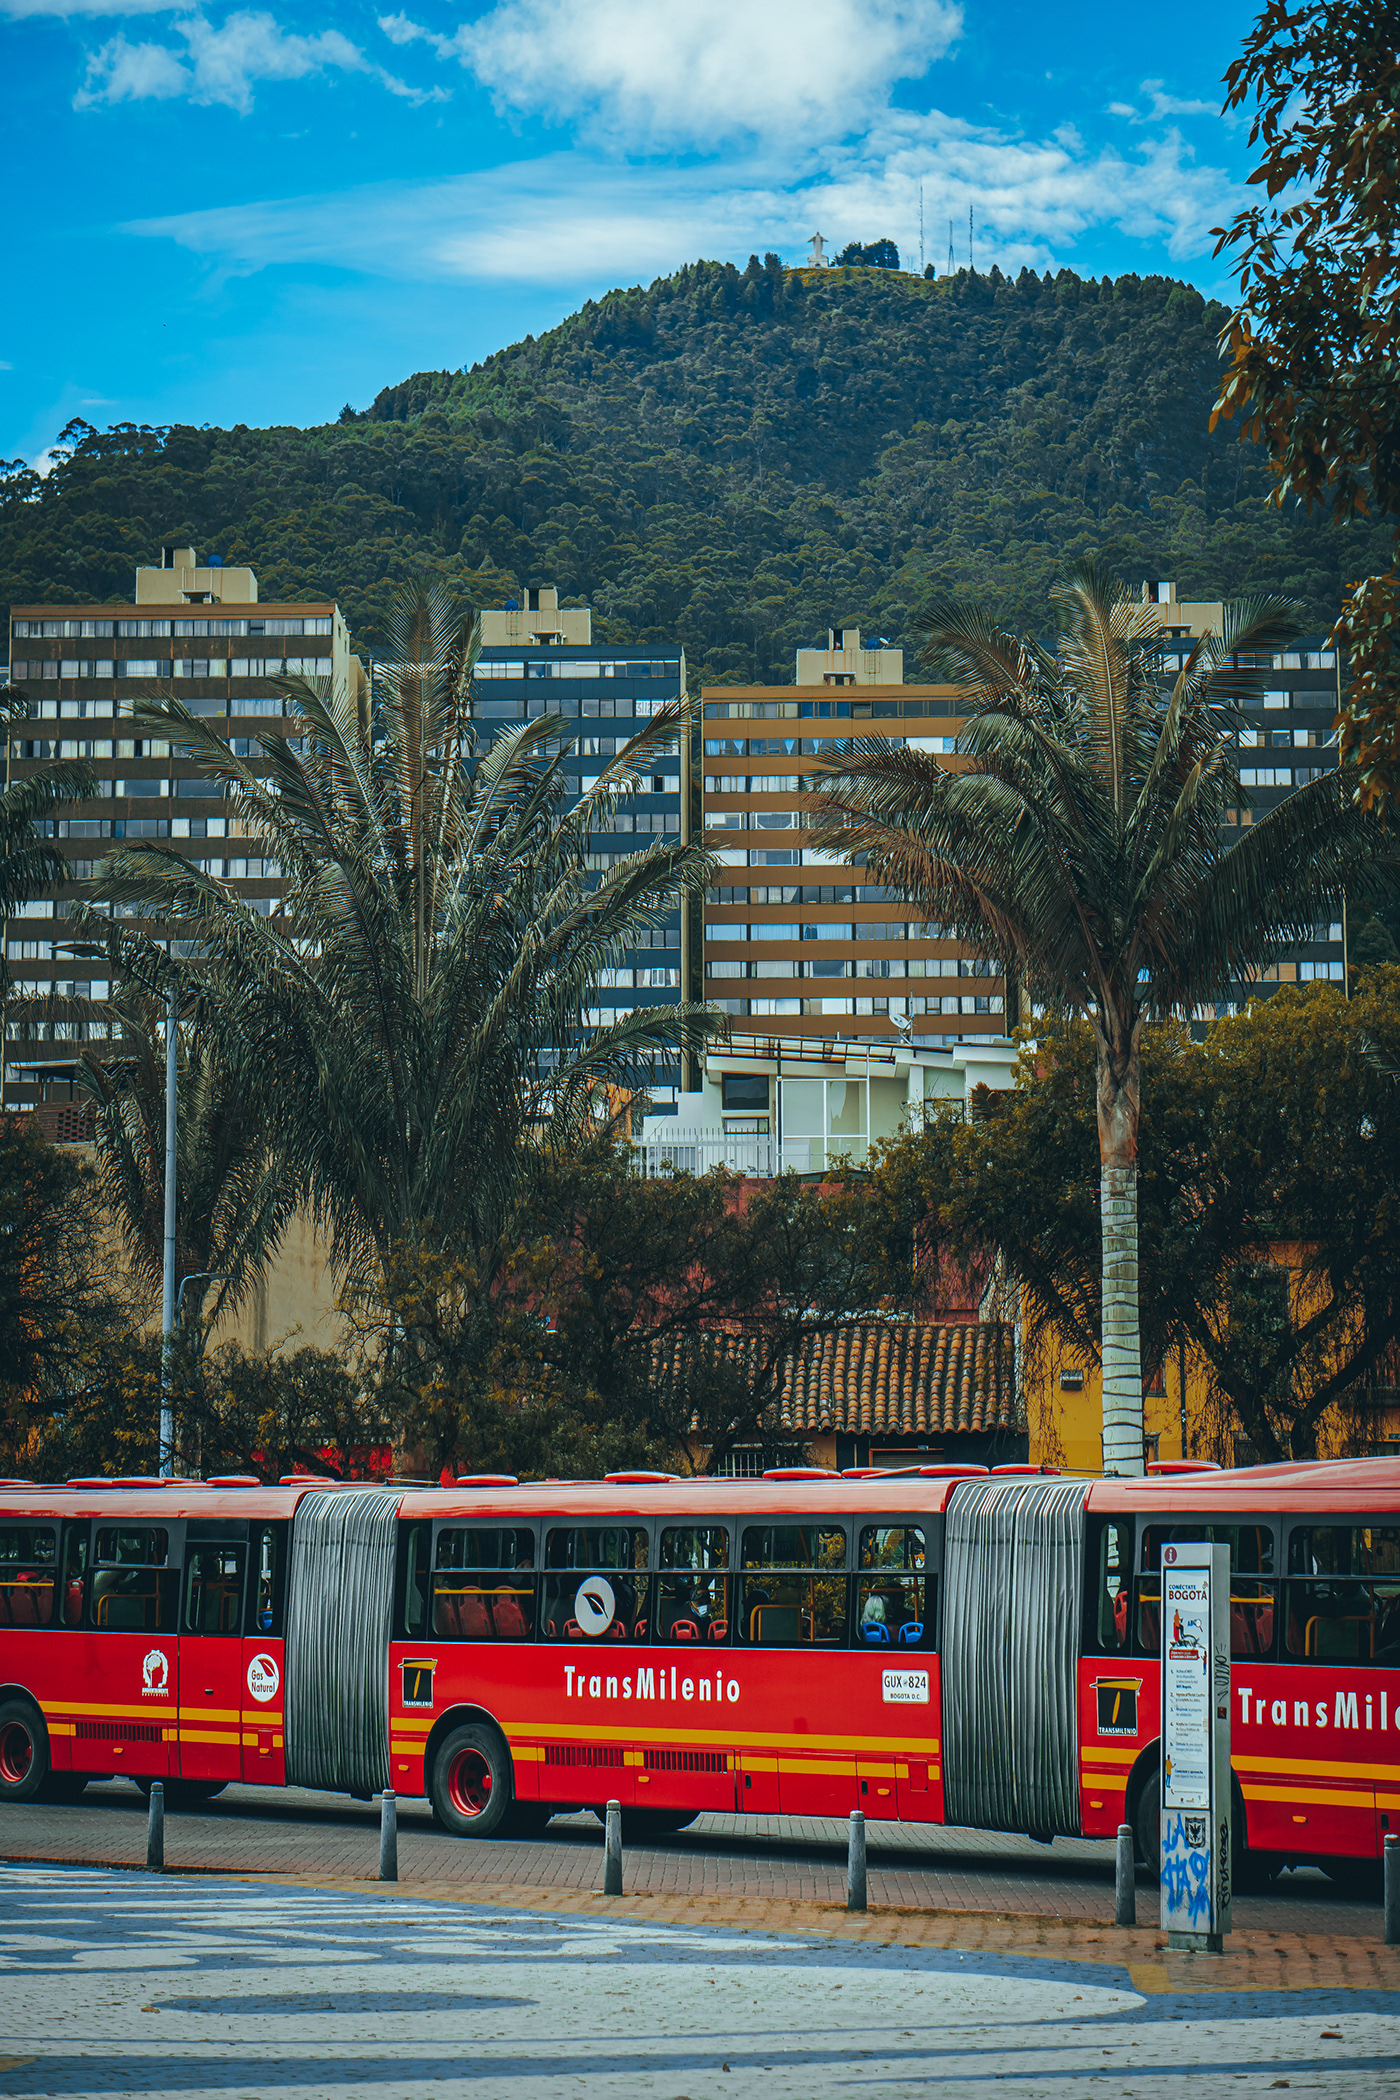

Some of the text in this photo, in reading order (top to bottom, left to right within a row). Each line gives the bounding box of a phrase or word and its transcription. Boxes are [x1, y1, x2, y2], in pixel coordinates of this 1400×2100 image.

[251, 1669, 264, 1680] Gas
[564, 1665, 740, 1702] TransMilenio
[884, 1675, 926, 1688] GUX 824
[251, 1682, 276, 1693] Natural
[1099, 1727, 1137, 1735] TRANSMILENIO
